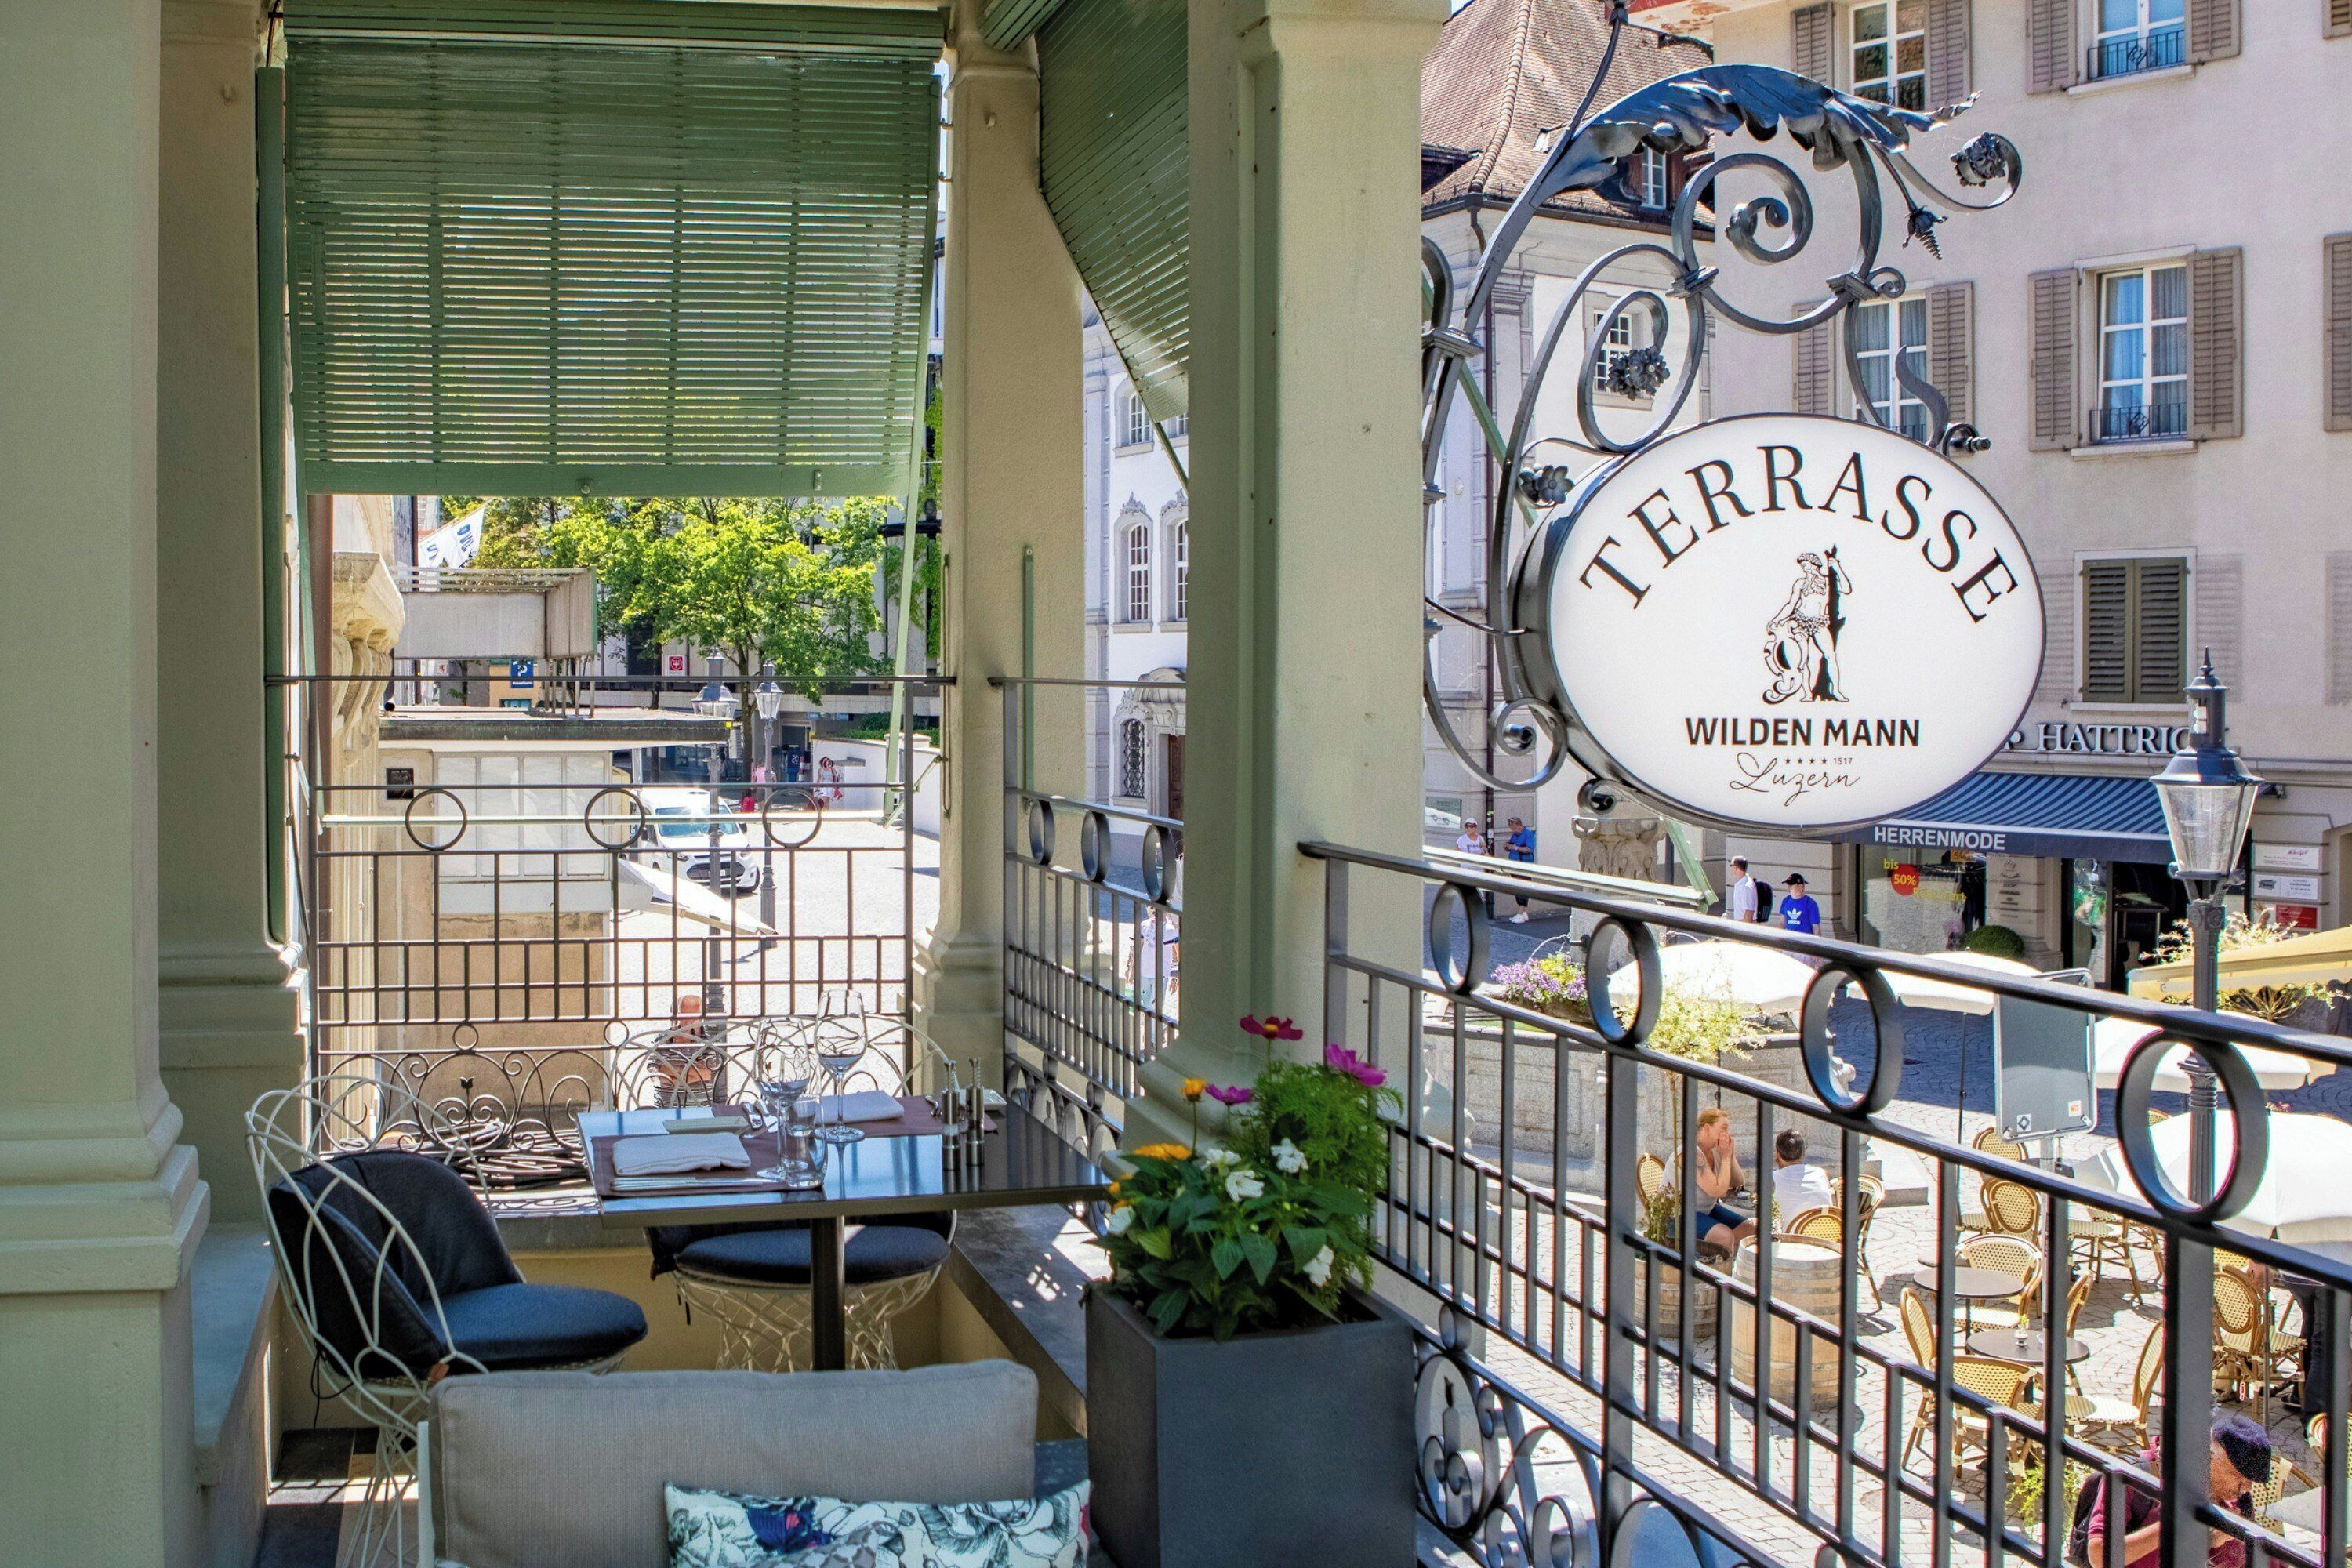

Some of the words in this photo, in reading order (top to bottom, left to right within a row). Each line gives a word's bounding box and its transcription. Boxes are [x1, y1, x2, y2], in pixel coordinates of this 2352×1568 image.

[1579, 445, 2019, 623] TERRASSE
[1685, 717, 1812, 746] WILDEN
[1824, 718, 1920, 746] MANN
[2036, 724, 2190, 754] HATTRIC
[1730, 752, 1860, 807] Luzern
[1875, 826, 2006, 851] HERRENMODE
[1883, 858, 1899, 869] bis
[1893, 873, 1916, 886] 50%
